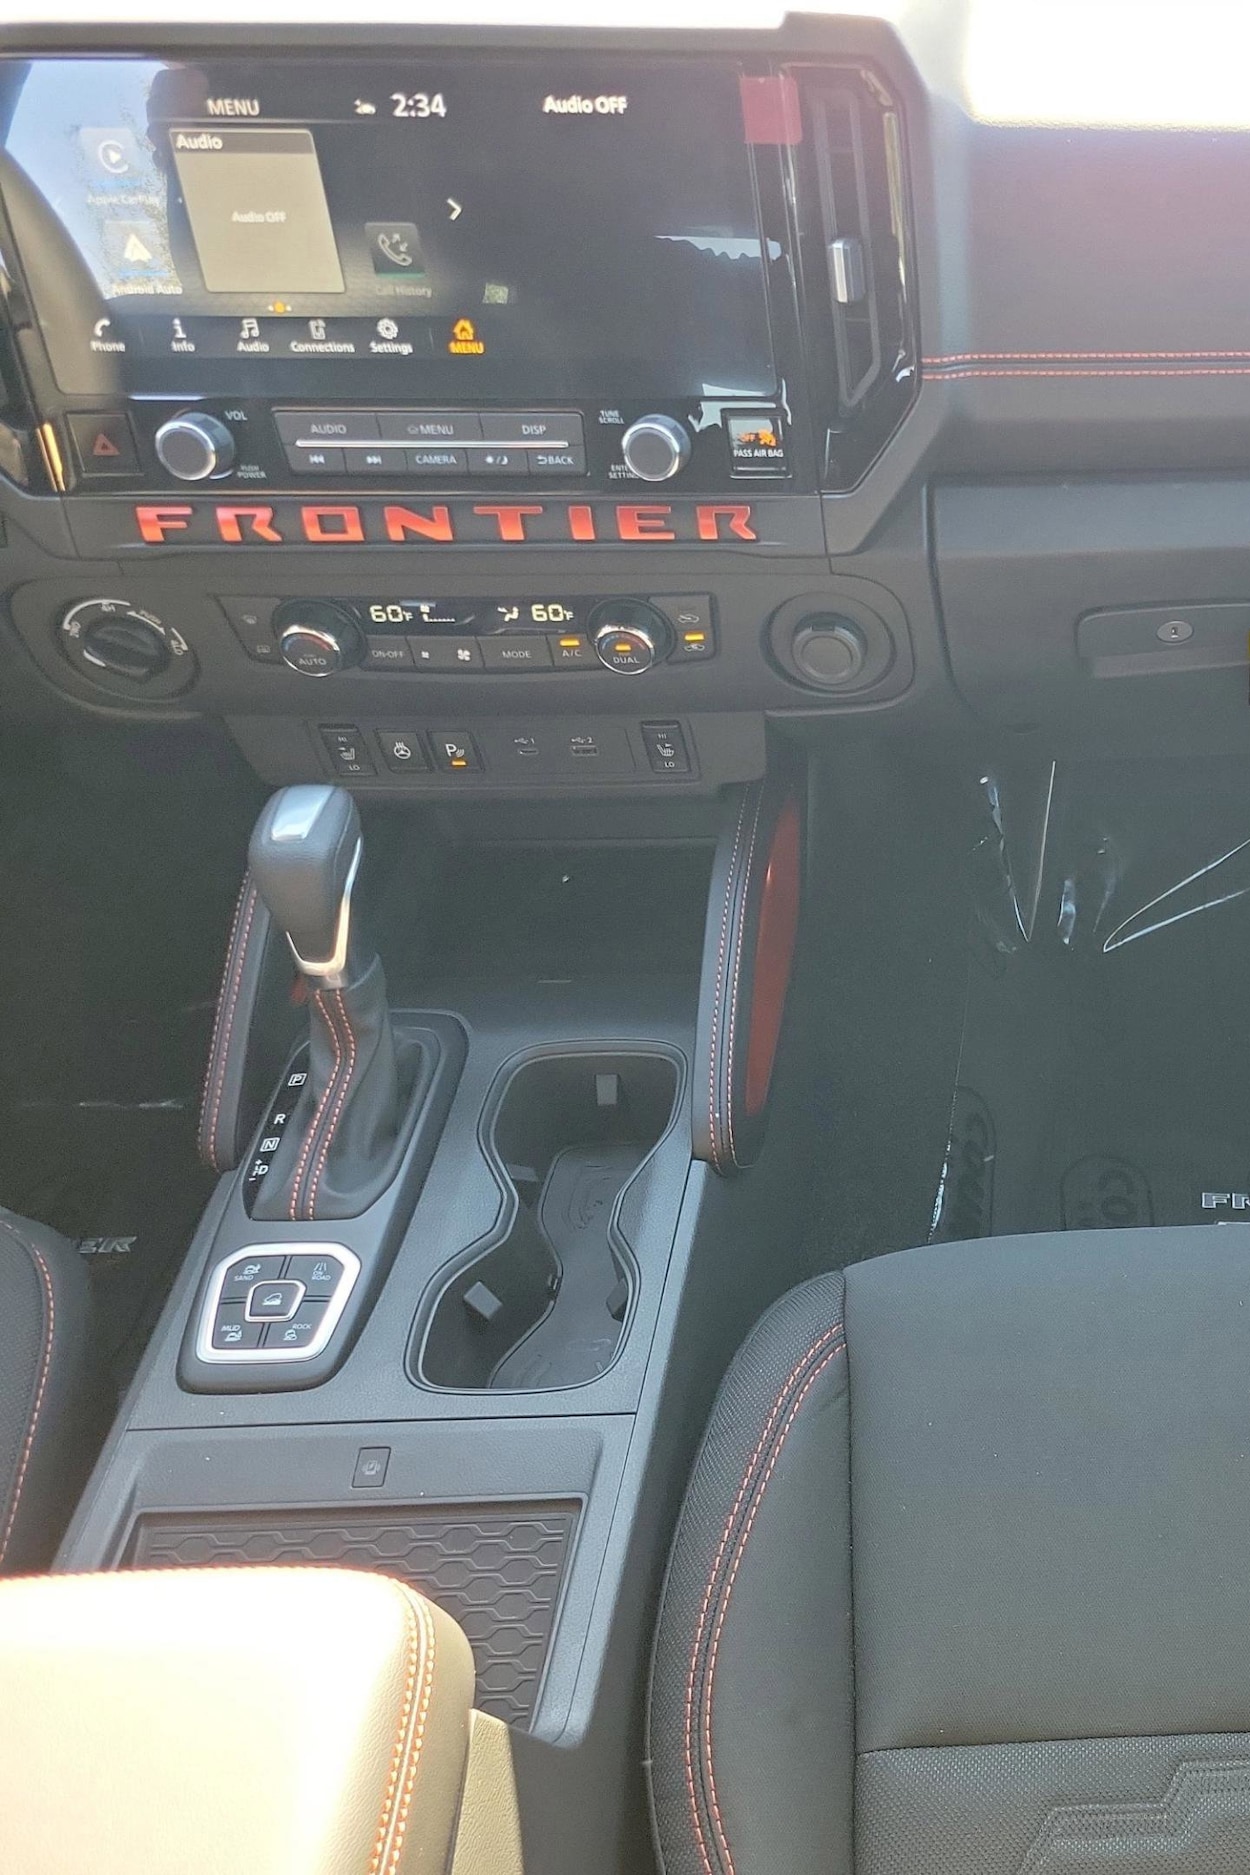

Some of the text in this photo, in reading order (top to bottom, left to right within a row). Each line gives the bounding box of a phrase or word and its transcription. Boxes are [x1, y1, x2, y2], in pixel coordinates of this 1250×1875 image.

[207, 98, 260, 116] MENU
[390, 92, 447, 118] 2:34
[543, 95, 628, 114] Audio OFF
[175, 133, 224, 150] Audio
[231, 210, 264, 223] Audio
[396, 285, 432, 298] History
[90, 340, 126, 352] Phone
[171, 340, 196, 352] Info
[237, 340, 270, 352] Audio
[290, 341, 356, 353] Connections
[369, 340, 413, 356] Settings
[449, 341, 485, 354] MENU
[224, 410, 248, 421] VOL
[310, 424, 347, 434] AUDIO
[419, 424, 454, 435] MENU
[521, 424, 547, 435] DISP
[733, 449, 784, 457] PASS AIR BAG
[415, 455, 457, 465] CAMERA
[548, 455, 574, 465] BACK
[610, 464, 628, 472] ENTE
[237, 471, 267, 479] POWER
[136, 505, 757, 543] FRONTIER
[502, 650, 532, 659] MODE
[612, 656, 640, 664] DUAL
[298, 657, 327, 666] AUTO
[445, 743, 457, 757] P
[292, 1075, 302, 1084] P
[274, 1113, 286, 1125] R
[264, 1140, 276, 1149] N
